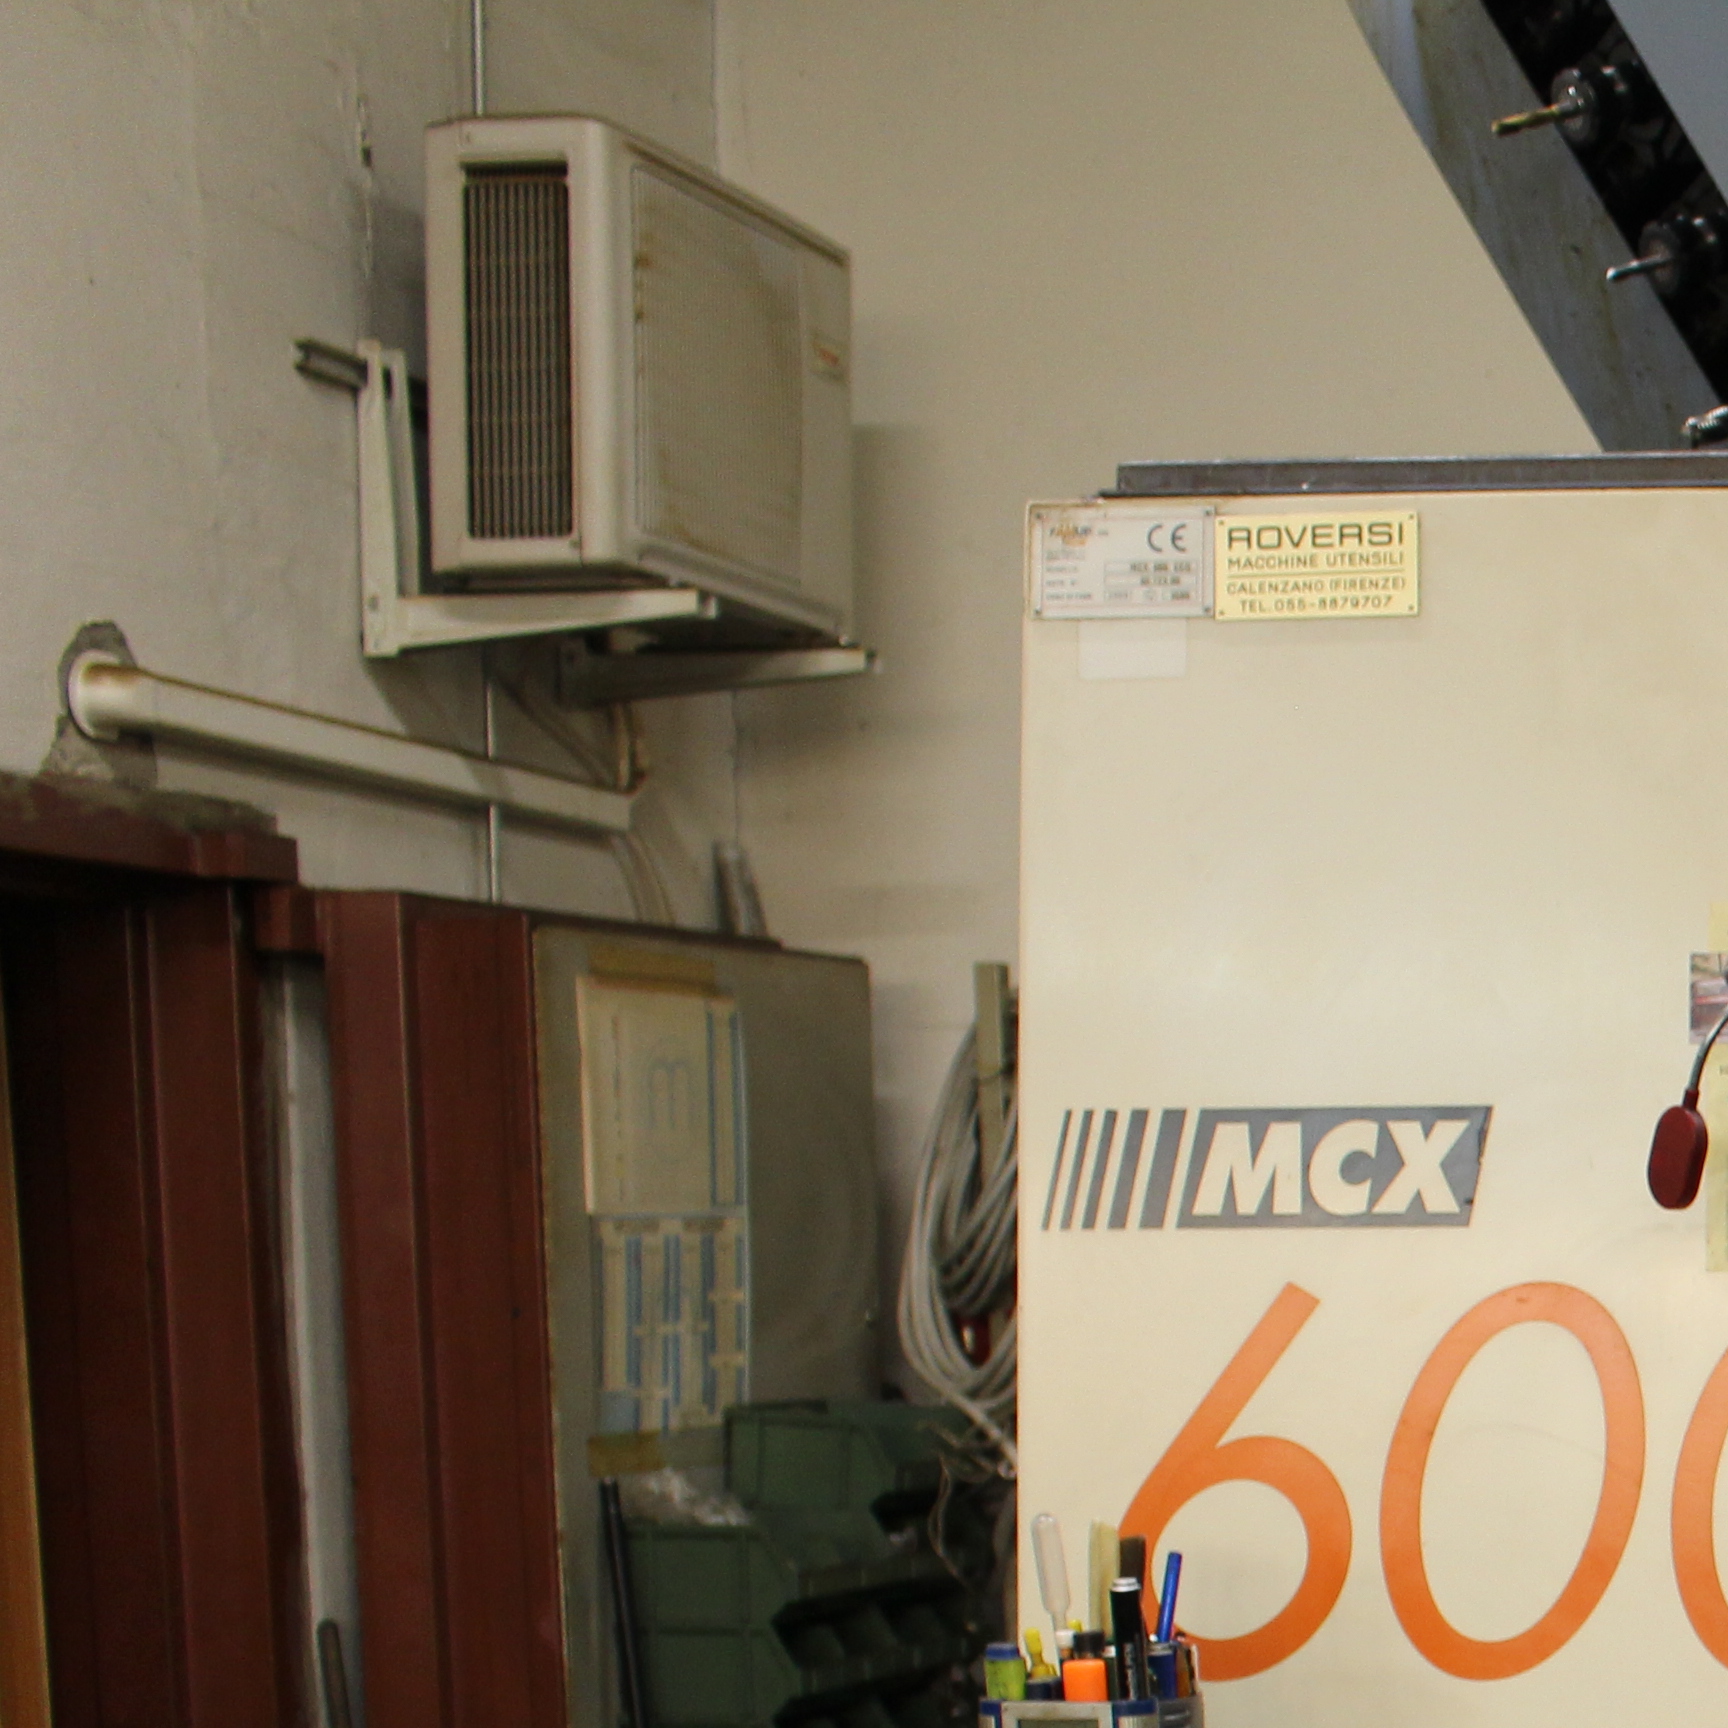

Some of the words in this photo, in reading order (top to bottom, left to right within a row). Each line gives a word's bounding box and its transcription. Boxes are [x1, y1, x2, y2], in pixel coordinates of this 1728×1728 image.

[1228, 522, 1404, 551] ROVERSI
[1227, 553, 1320, 571] MACCHINE
[1326, 551, 1404, 569] UTENSILI
[1227, 579, 1325, 595] CALENZANO
[1329, 576, 1406, 593] (FIRENZE)
[1194, 1120, 1475, 1216] MCX
